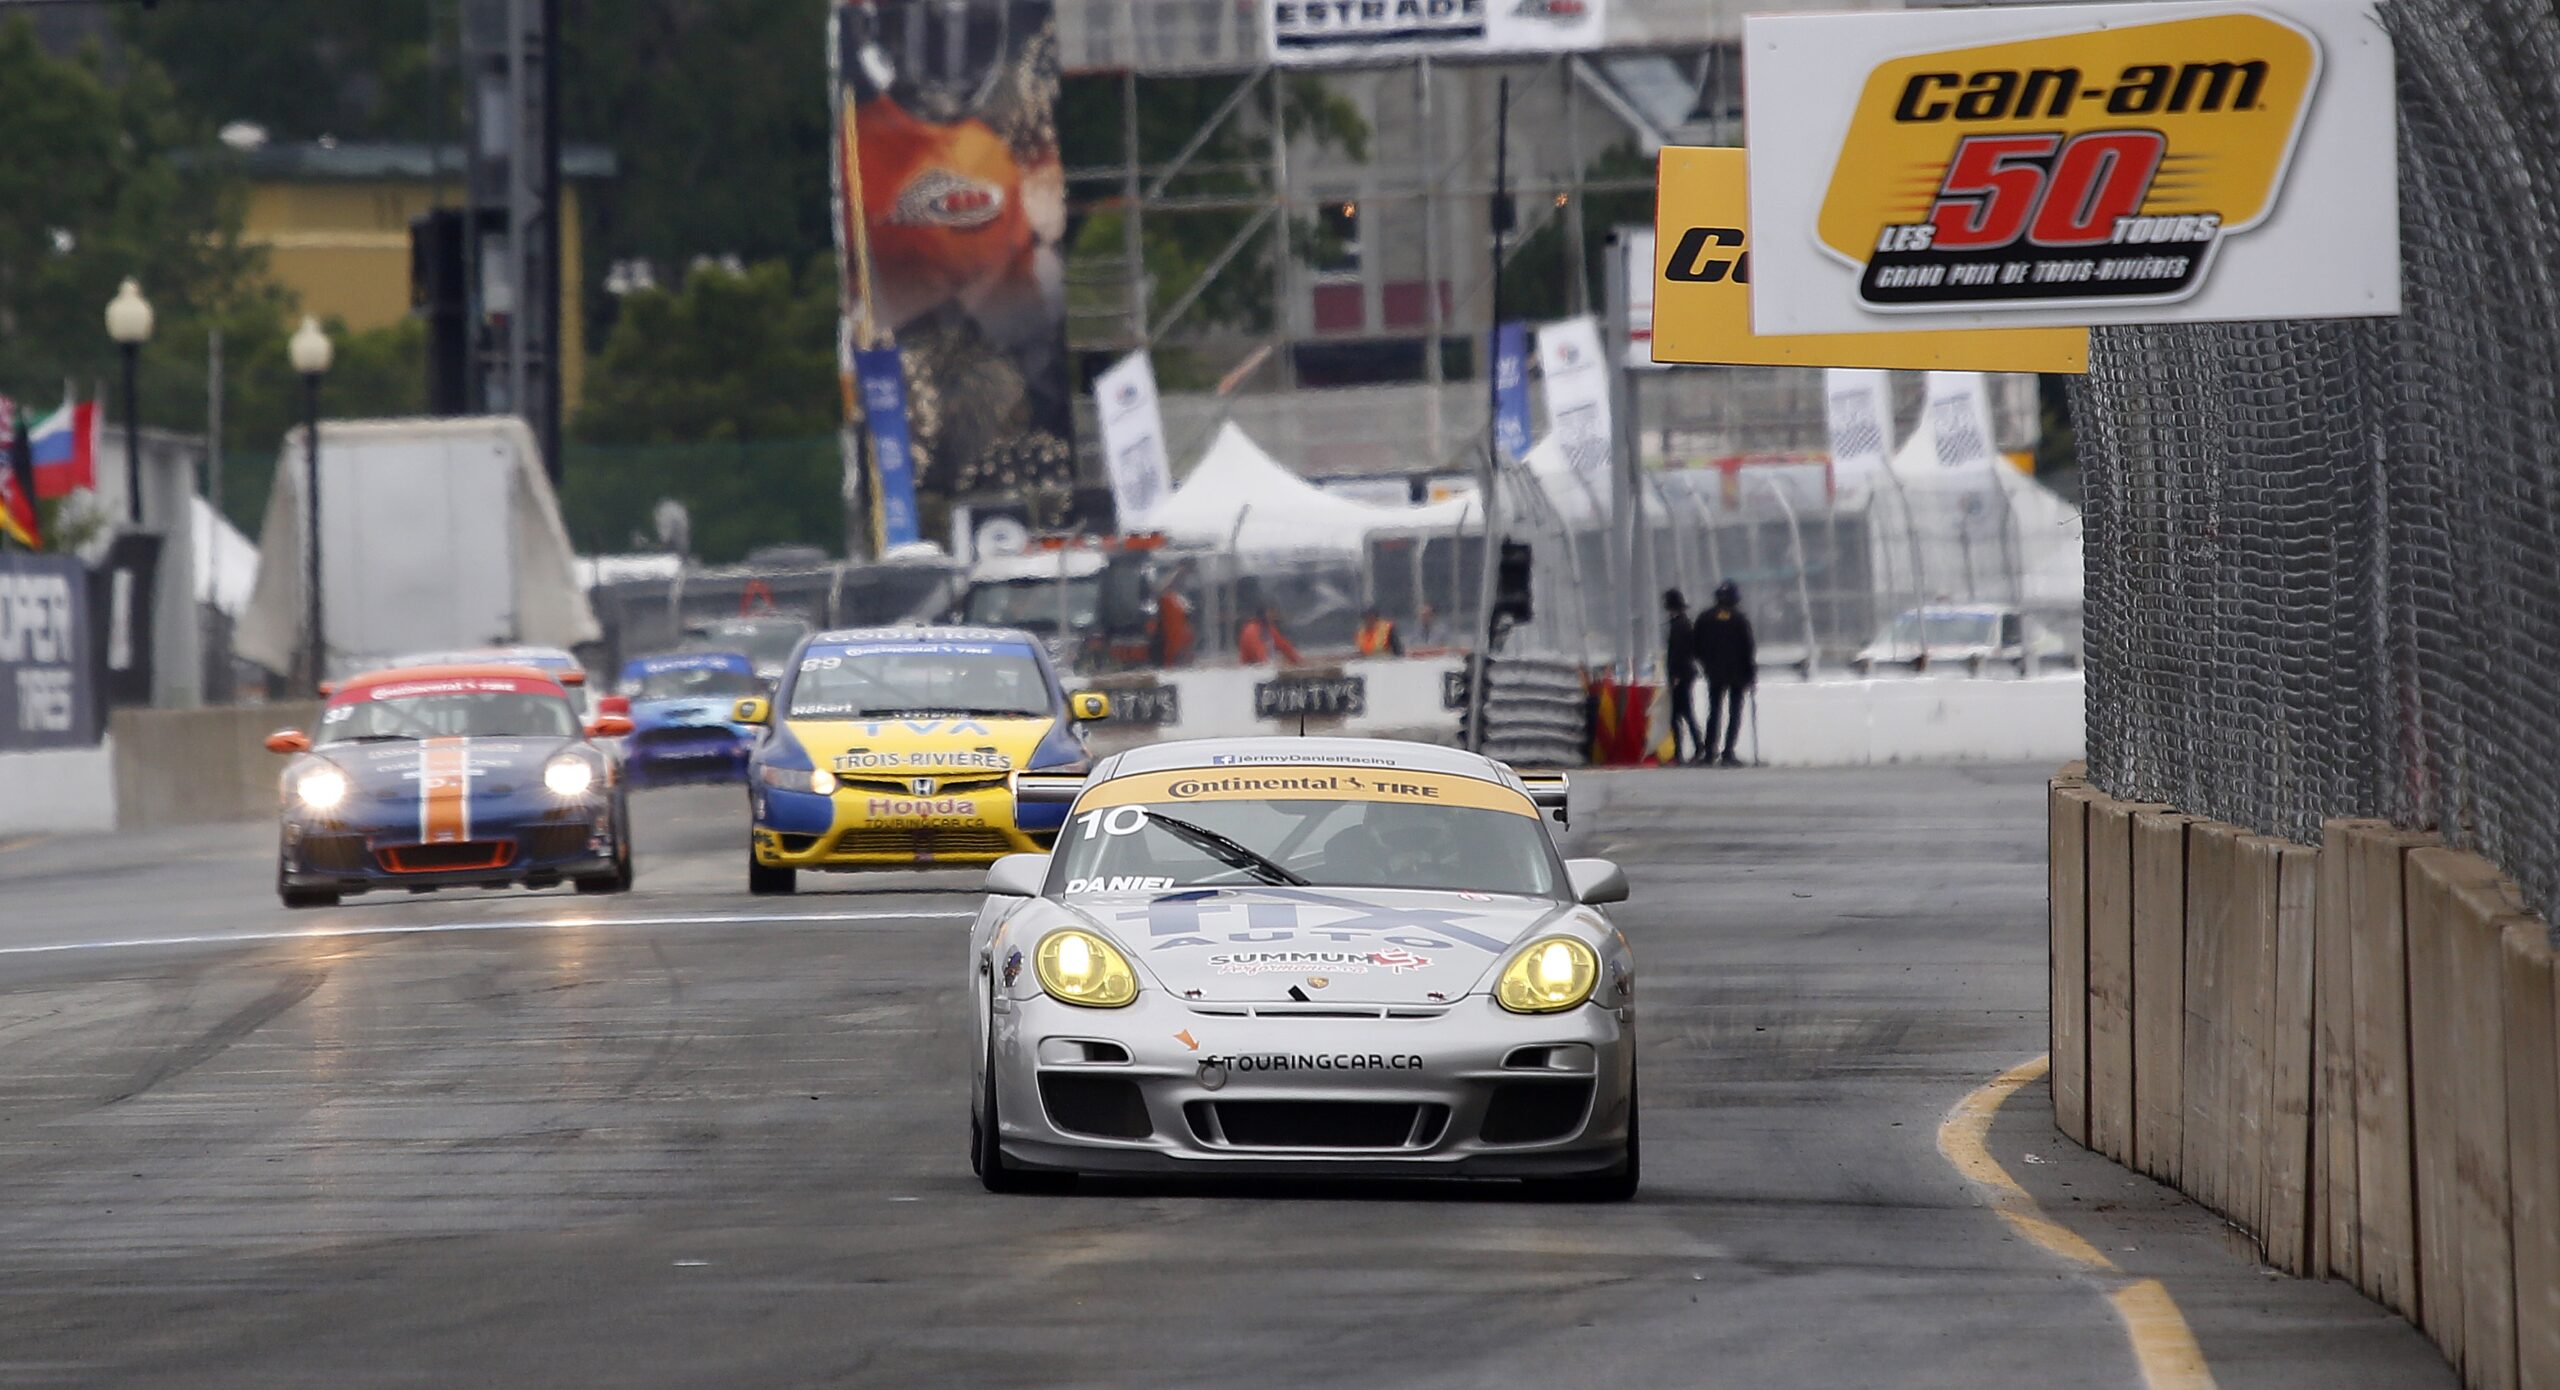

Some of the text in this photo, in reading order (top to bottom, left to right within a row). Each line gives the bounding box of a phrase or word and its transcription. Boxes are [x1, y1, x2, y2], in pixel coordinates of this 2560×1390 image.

[1892, 58, 2270, 124] can-am
[1930, 129, 2169, 250] 50
[1877, 214, 2221, 253] LES TOURS
[1875, 253, 2190, 289] GRAND PRIX DE TROIS-RIVIÈRES
[833, 752, 1012, 770] TROIS-RIVIÈRES
[1168, 777, 1440, 799] Continental TIRE
[868, 799, 975, 816] Honda
[1077, 804, 1150, 841] 10
[1150, 931, 1454, 951] AUTO
[1211, 952, 1375, 965] SUMMUM
